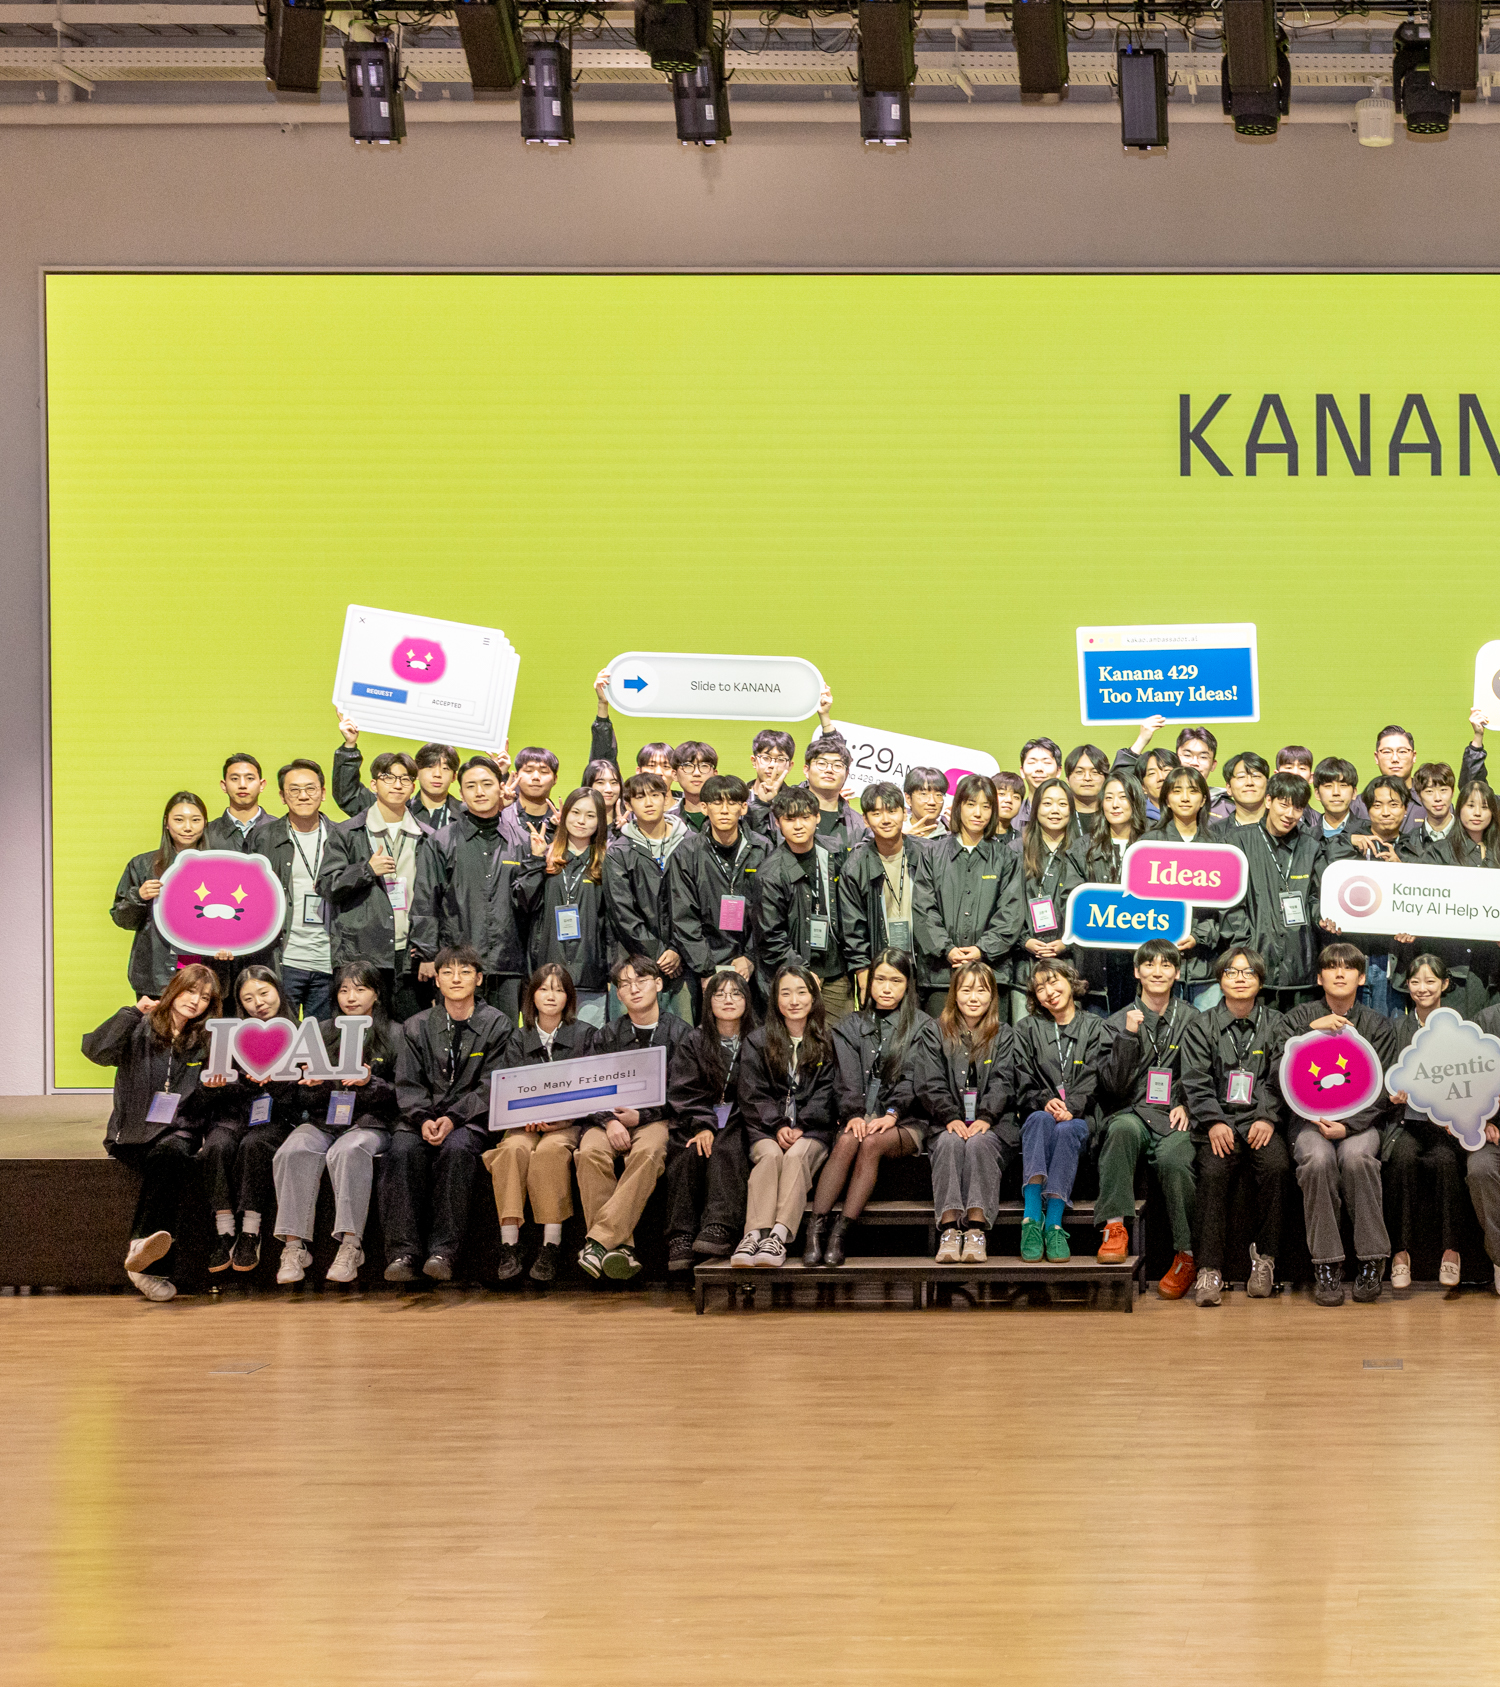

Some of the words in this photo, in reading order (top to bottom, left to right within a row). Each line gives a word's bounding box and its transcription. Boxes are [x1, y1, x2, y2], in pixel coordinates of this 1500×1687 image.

[1098, 665, 1165, 682] Kanana
[1167, 664, 1199, 680] 429
[365, 687, 394, 698] REQUEST
[690, 680, 716, 692] Slide
[718, 681, 732, 692] to
[733, 681, 782, 694] KANANA
[1099, 687, 1133, 704] Too
[1135, 687, 1185, 707] Many
[1187, 685, 1239, 702] Ideas!
[431, 699, 463, 710] ACCEPTED
[1147, 860, 1222, 888] Ideas
[1392, 882, 1451, 898] Kanana
[1086, 903, 1170, 932] Meets
[1391, 899, 1424, 916] May
[1426, 901, 1441, 915] AI
[1445, 903, 1479, 920] Help
[204, 1021, 239, 1078] I
[274, 1019, 368, 1077] AI
[1412, 1055, 1496, 1085] Agentic
[517, 1085, 538, 1094] Too
[543, 1079, 573, 1090] Many
[578, 1069, 637, 1085] Friends!!
[1445, 1080, 1473, 1101] AI
